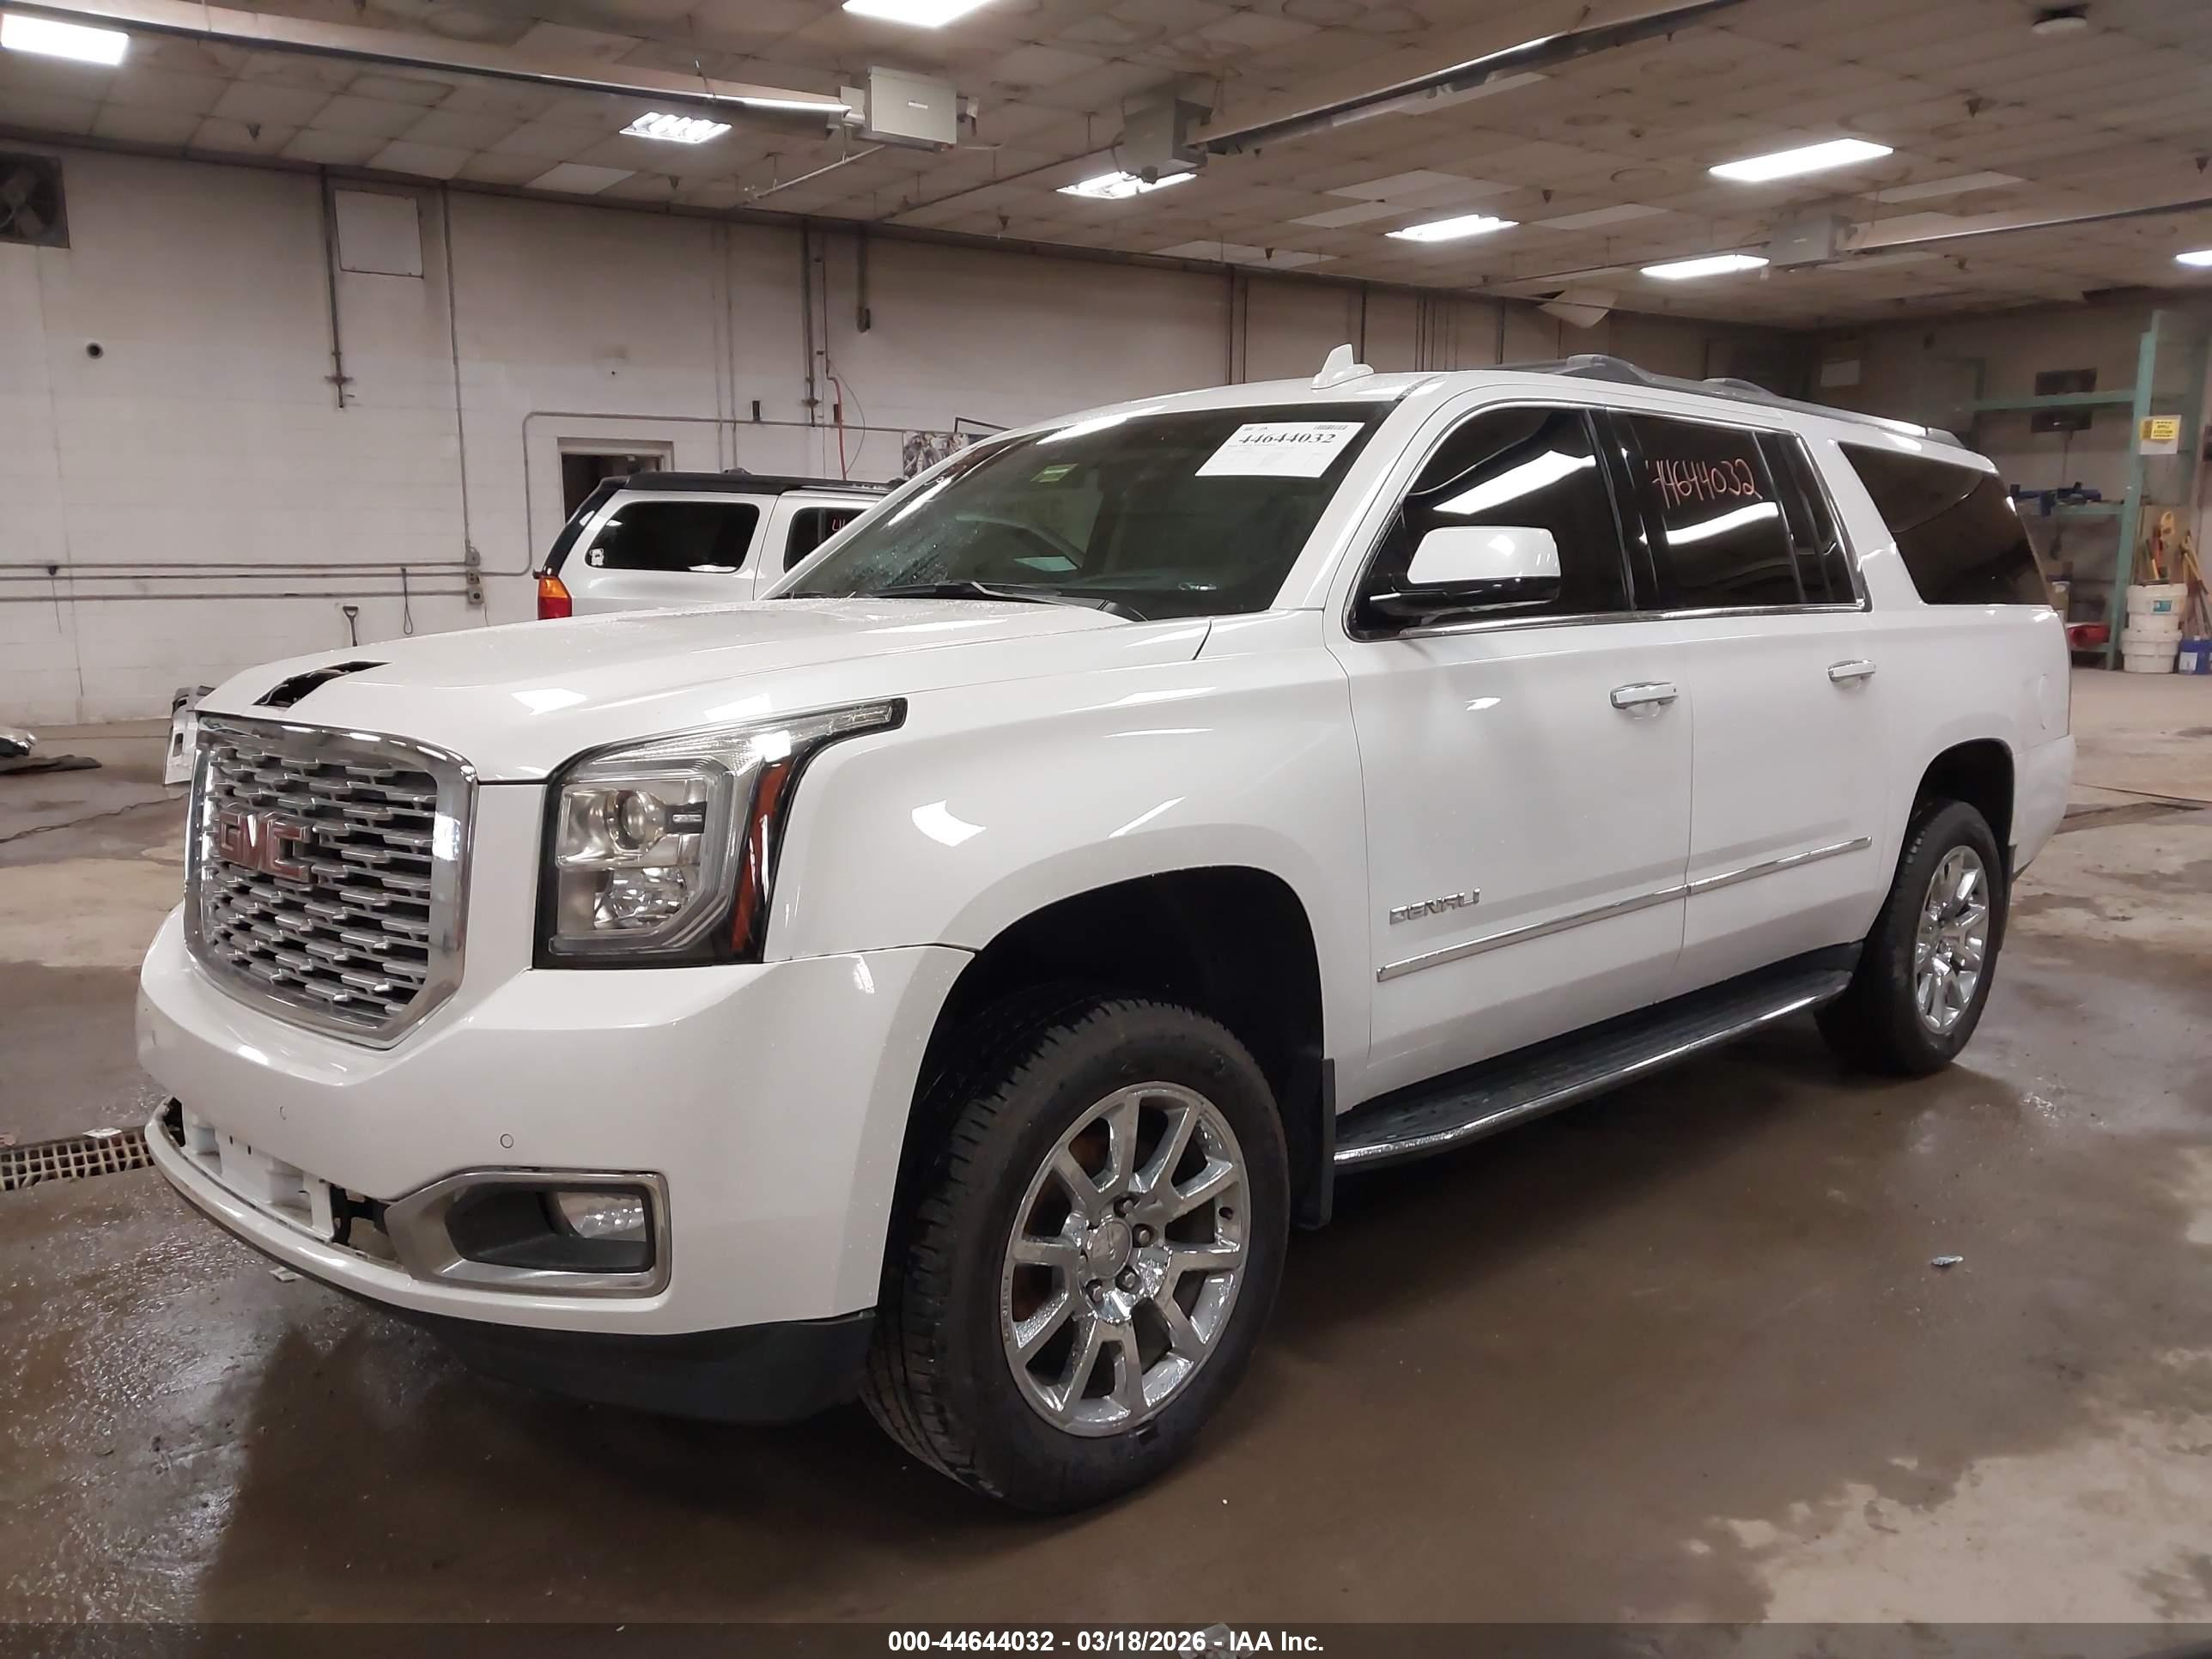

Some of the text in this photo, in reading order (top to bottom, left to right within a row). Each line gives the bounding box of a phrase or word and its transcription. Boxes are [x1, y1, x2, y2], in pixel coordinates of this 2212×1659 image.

[1238, 432, 1337, 444] 44644032
[219, 808, 312, 884] GMC
[1389, 888, 1481, 925] DENALI
